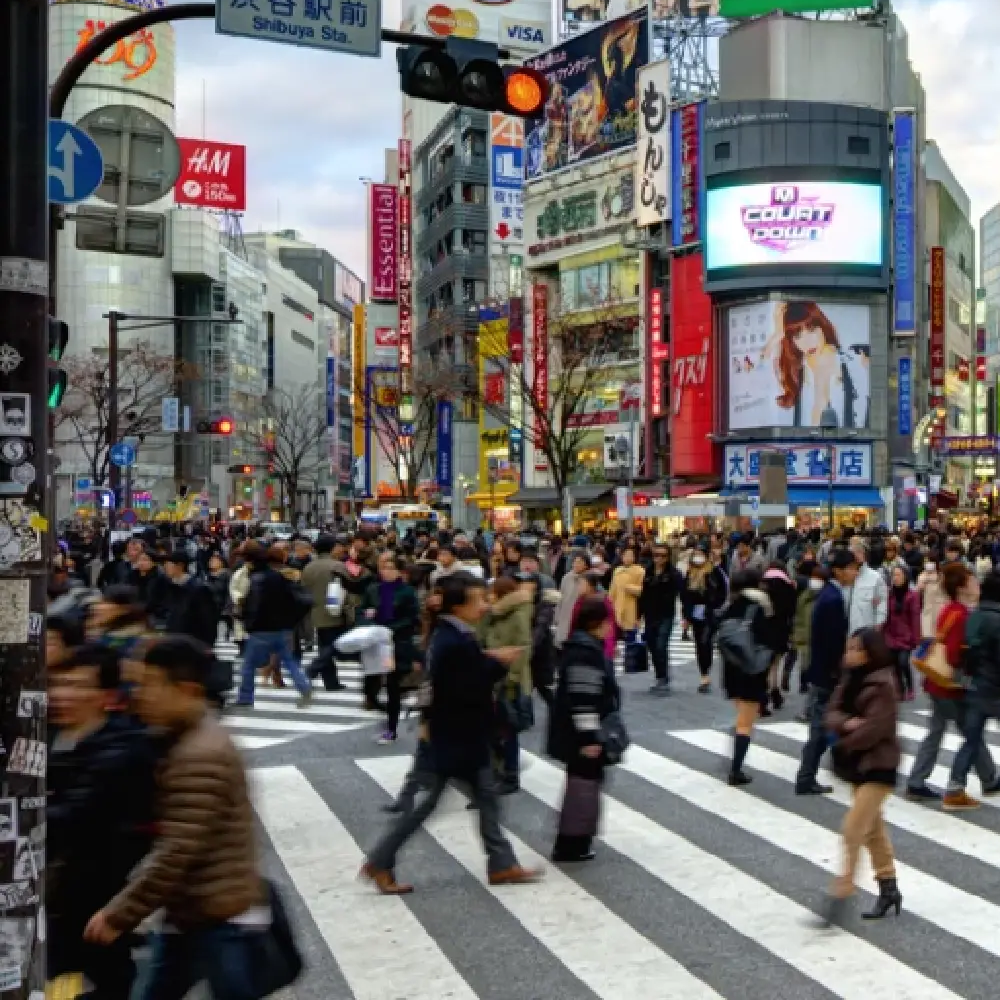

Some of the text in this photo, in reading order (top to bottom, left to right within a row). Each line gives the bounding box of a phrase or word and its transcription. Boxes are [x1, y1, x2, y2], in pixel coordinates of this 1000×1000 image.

[252, 15, 353, 44] Shibuya Sta.
[507, 25, 544, 44] VISA
[641, 80, 667, 217] もんじゃ
[373, 186, 394, 293] Essential
